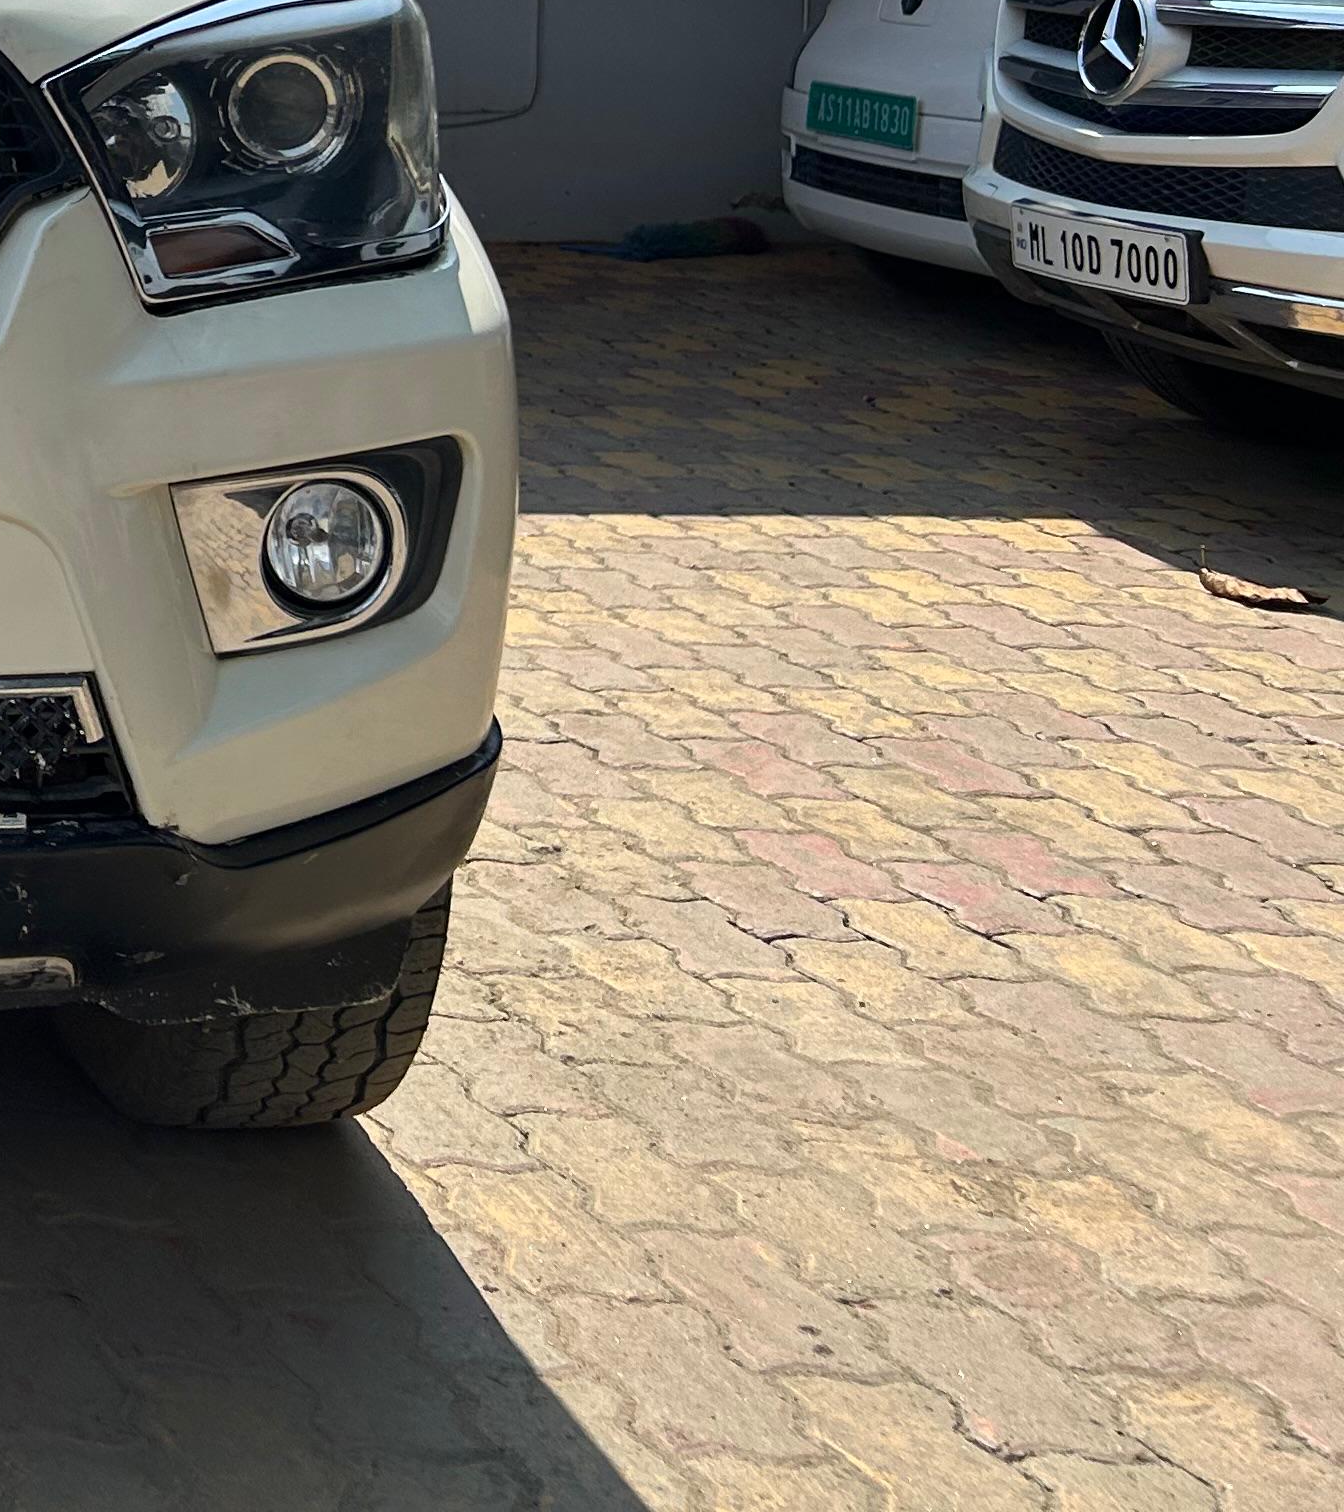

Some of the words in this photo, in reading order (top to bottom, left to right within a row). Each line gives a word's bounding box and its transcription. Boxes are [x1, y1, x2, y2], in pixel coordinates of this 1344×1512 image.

[817, 92, 910, 136] AS11AB1830
[1028, 221, 1054, 266] ML
[1060, 230, 1101, 275] 10D
[1110, 238, 1178, 289] 7000
